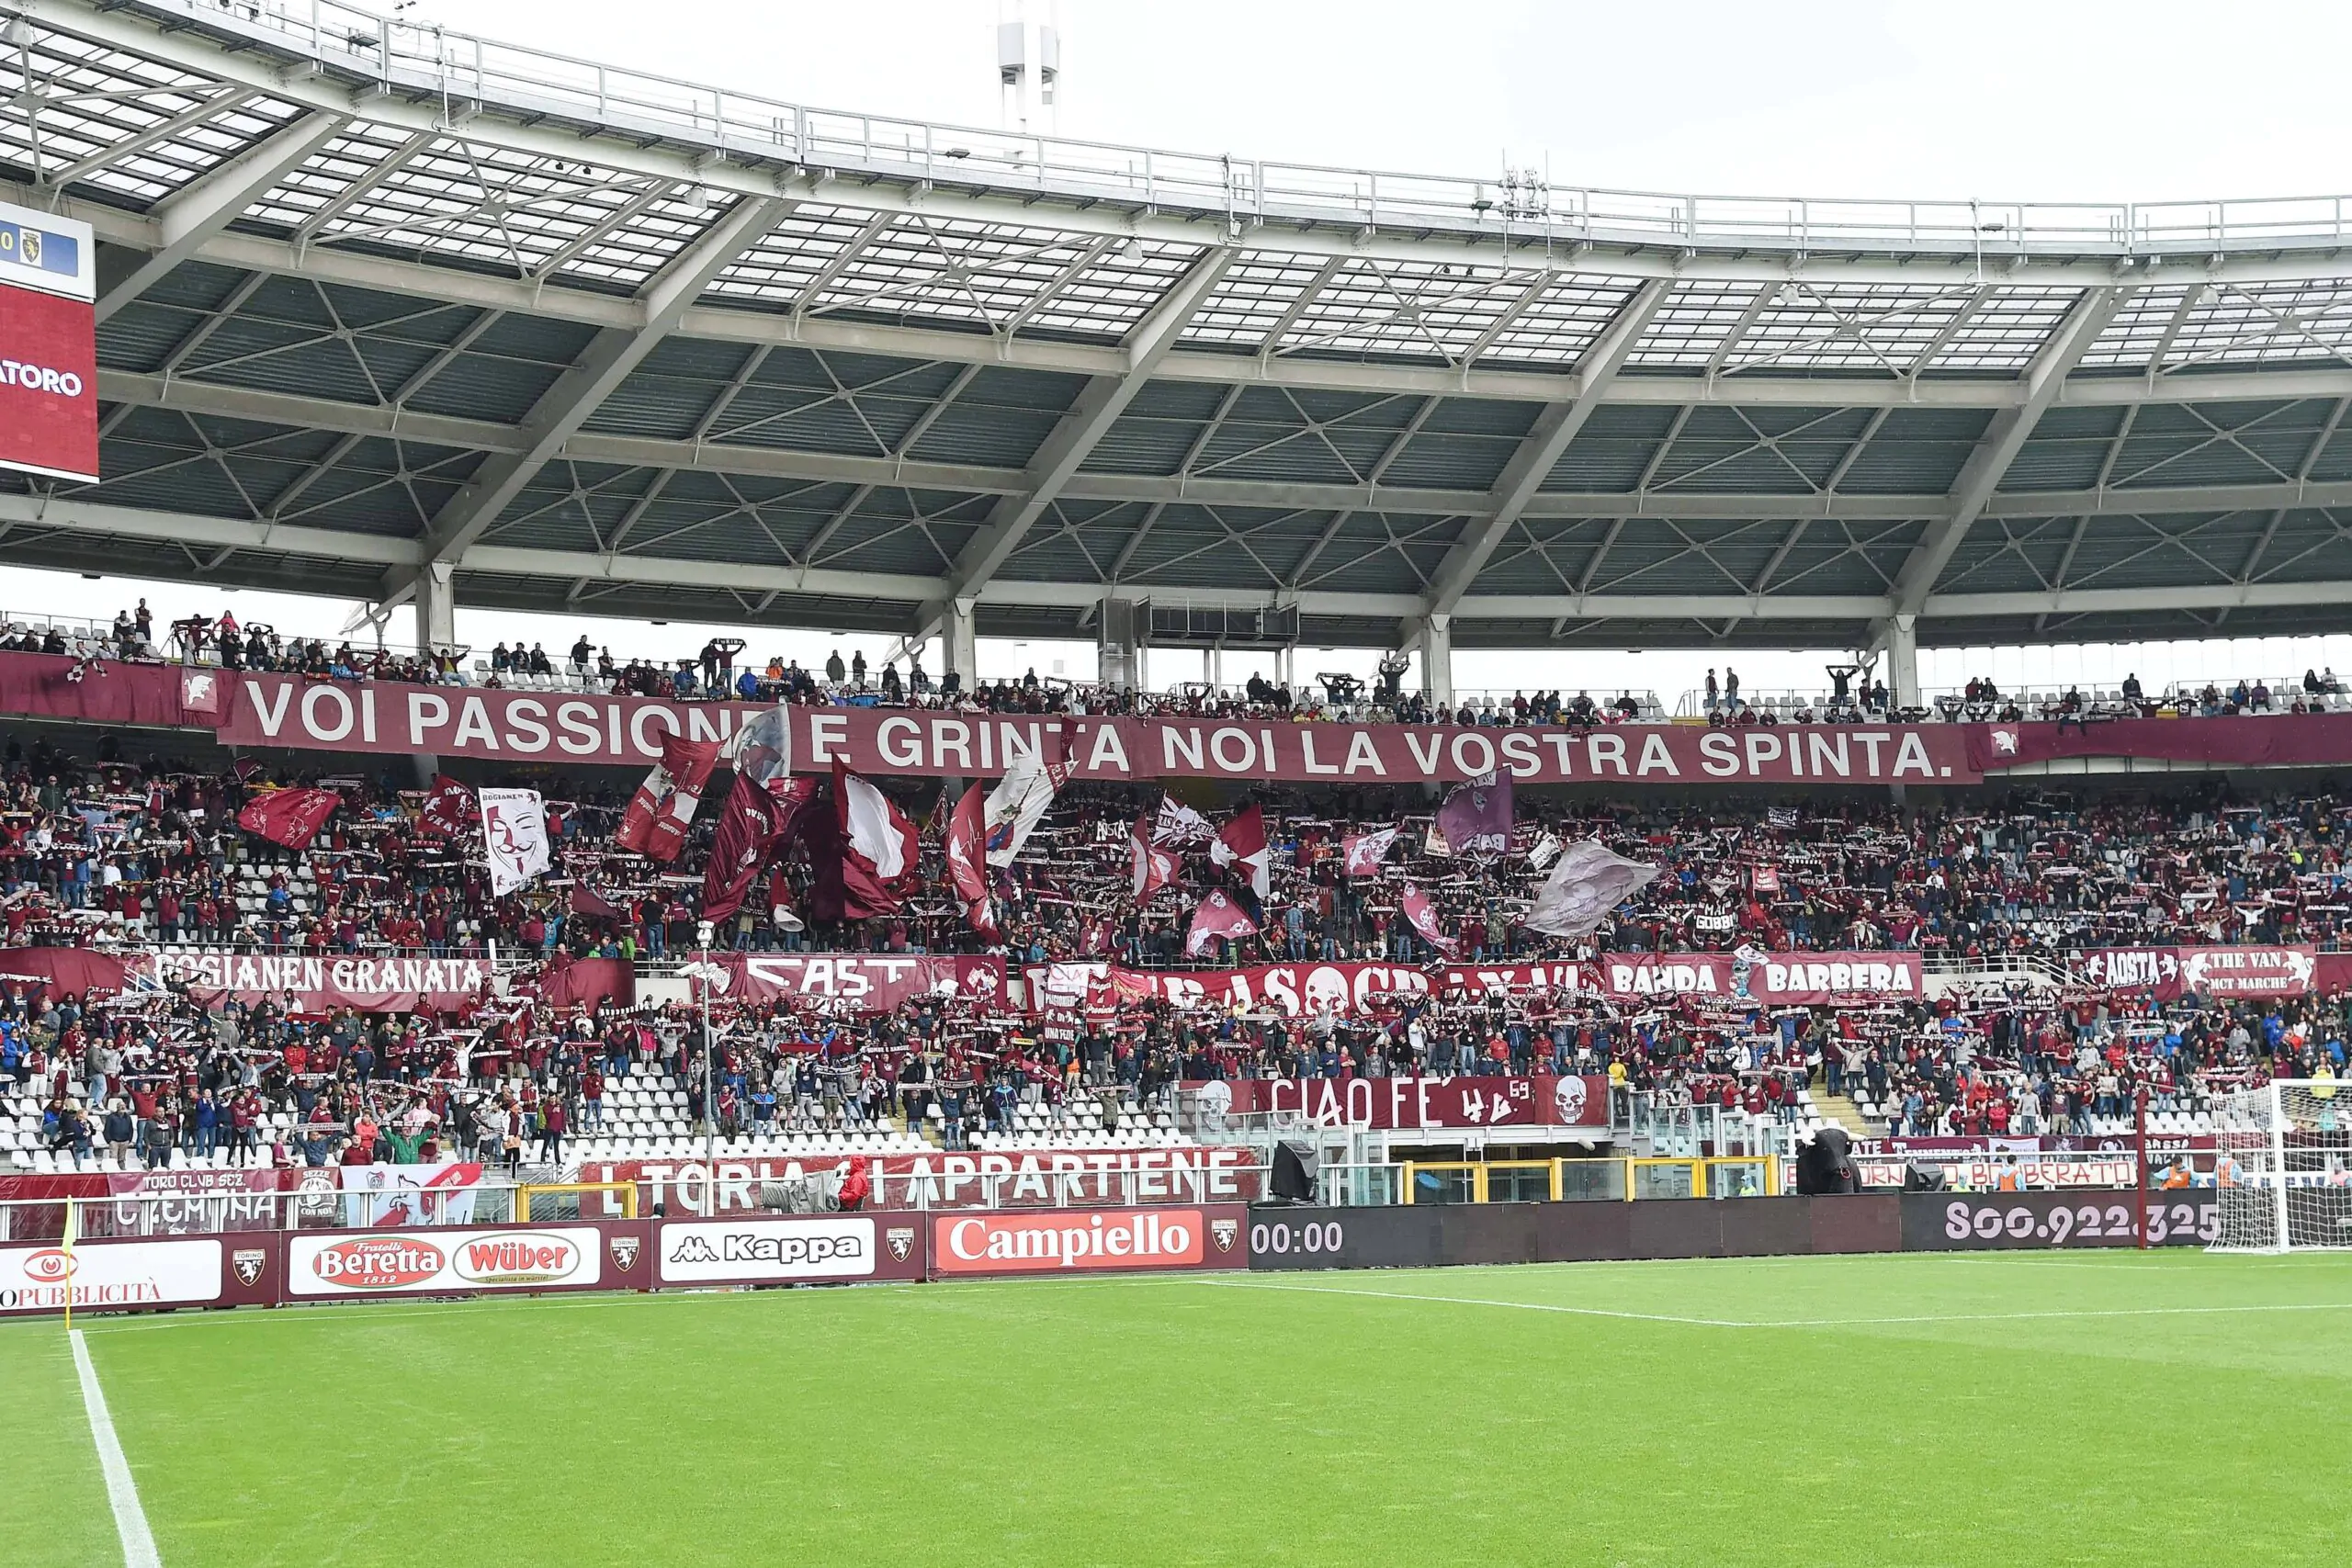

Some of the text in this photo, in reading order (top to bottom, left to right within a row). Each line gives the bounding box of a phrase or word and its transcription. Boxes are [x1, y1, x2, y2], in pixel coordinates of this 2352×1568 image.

[244, 681, 377, 743] VOI
[407, 692, 764, 760] PASSION
[810, 714, 853, 764] E
[1162, 726, 1277, 774] NOI
[1301, 729, 1387, 776] LA
[1404, 731, 1681, 778] VOSTRA
[1701, 731, 1951, 778] SPINTA.
[1696, 915, 1735, 930] GOBBI
[2105, 951, 2161, 989] AOSTA
[2210, 952, 2282, 969] THE VAN
[331, 959, 482, 993] GRANATA
[1612, 964, 1717, 993] BANDA
[1766, 963, 1913, 992] BARBERA
[2210, 976, 2288, 990] MCT MARCHE
[1045, 1027, 1075, 1041] UNA FEDE
[1271, 1078, 1374, 1130] CIAO
[1509, 1079, 1530, 1100] 69
[143, 1175, 177, 1189] TORO
[303, 1169, 331, 1178] SEZZE
[905, 1151, 1238, 1202] APPARTIENE
[354, 1241, 404, 1253] Fratelli
[724, 1235, 862, 1264] Kappa
[949, 1213, 1191, 1267] Campiello
[1251, 1222, 1343, 1255] 00:00
[319, 1248, 442, 1278] Beretta
[469, 1242, 569, 1272] Wüber
[362, 1275, 397, 1284] 1812
